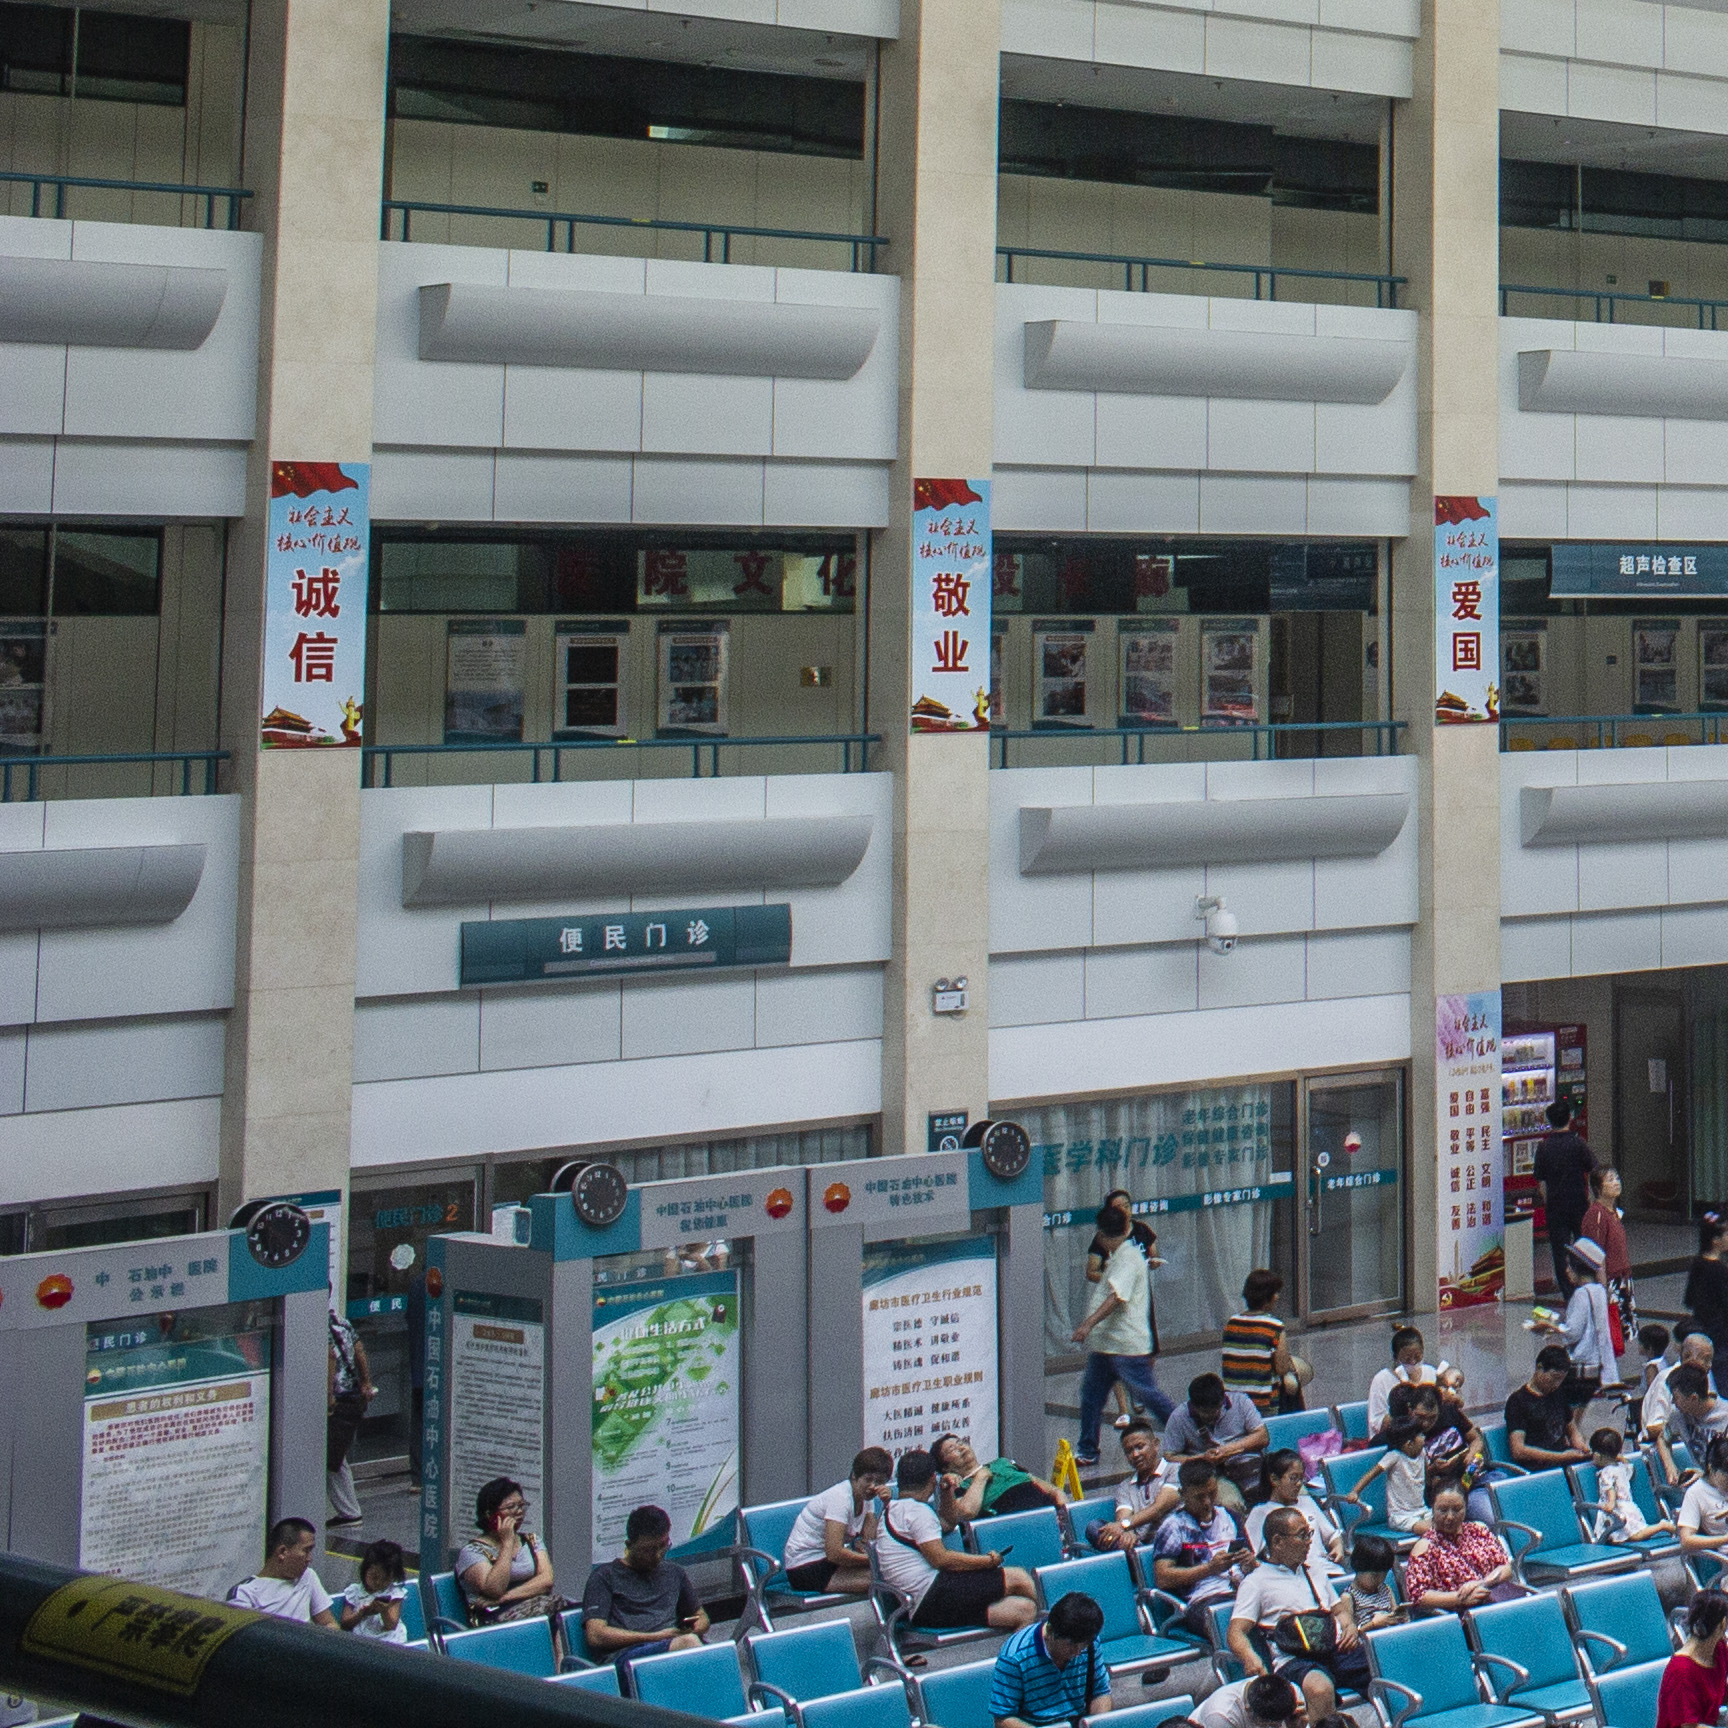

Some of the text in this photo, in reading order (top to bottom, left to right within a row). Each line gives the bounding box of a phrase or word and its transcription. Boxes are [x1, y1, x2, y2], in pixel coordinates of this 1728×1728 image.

[289, 506, 353, 526] 社会主义
[928, 517, 979, 536] 社会主义
[277, 533, 361, 555] 核心价值观
[920, 542, 986, 561] 核心价值观
[1619, 554, 1698, 575] 超声检查区
[289, 568, 340, 682] 诚信
[932, 573, 971, 672] 敬业
[1452, 581, 1482, 672] 爱国
[559, 920, 710, 954] 便民门诊
[865, 1173, 957, 1194] 中国石油中心医院
[1327, 1172, 1381, 1190] 老年综合门诊
[656, 1194, 753, 1216] 中国石油中心医院
[889, 1190, 934, 1207] 特色技术
[869, 1285, 982, 1311] 廊坊市医疗卫生行业规范
[424, 1307, 441, 1538] 中国石油中心医院
